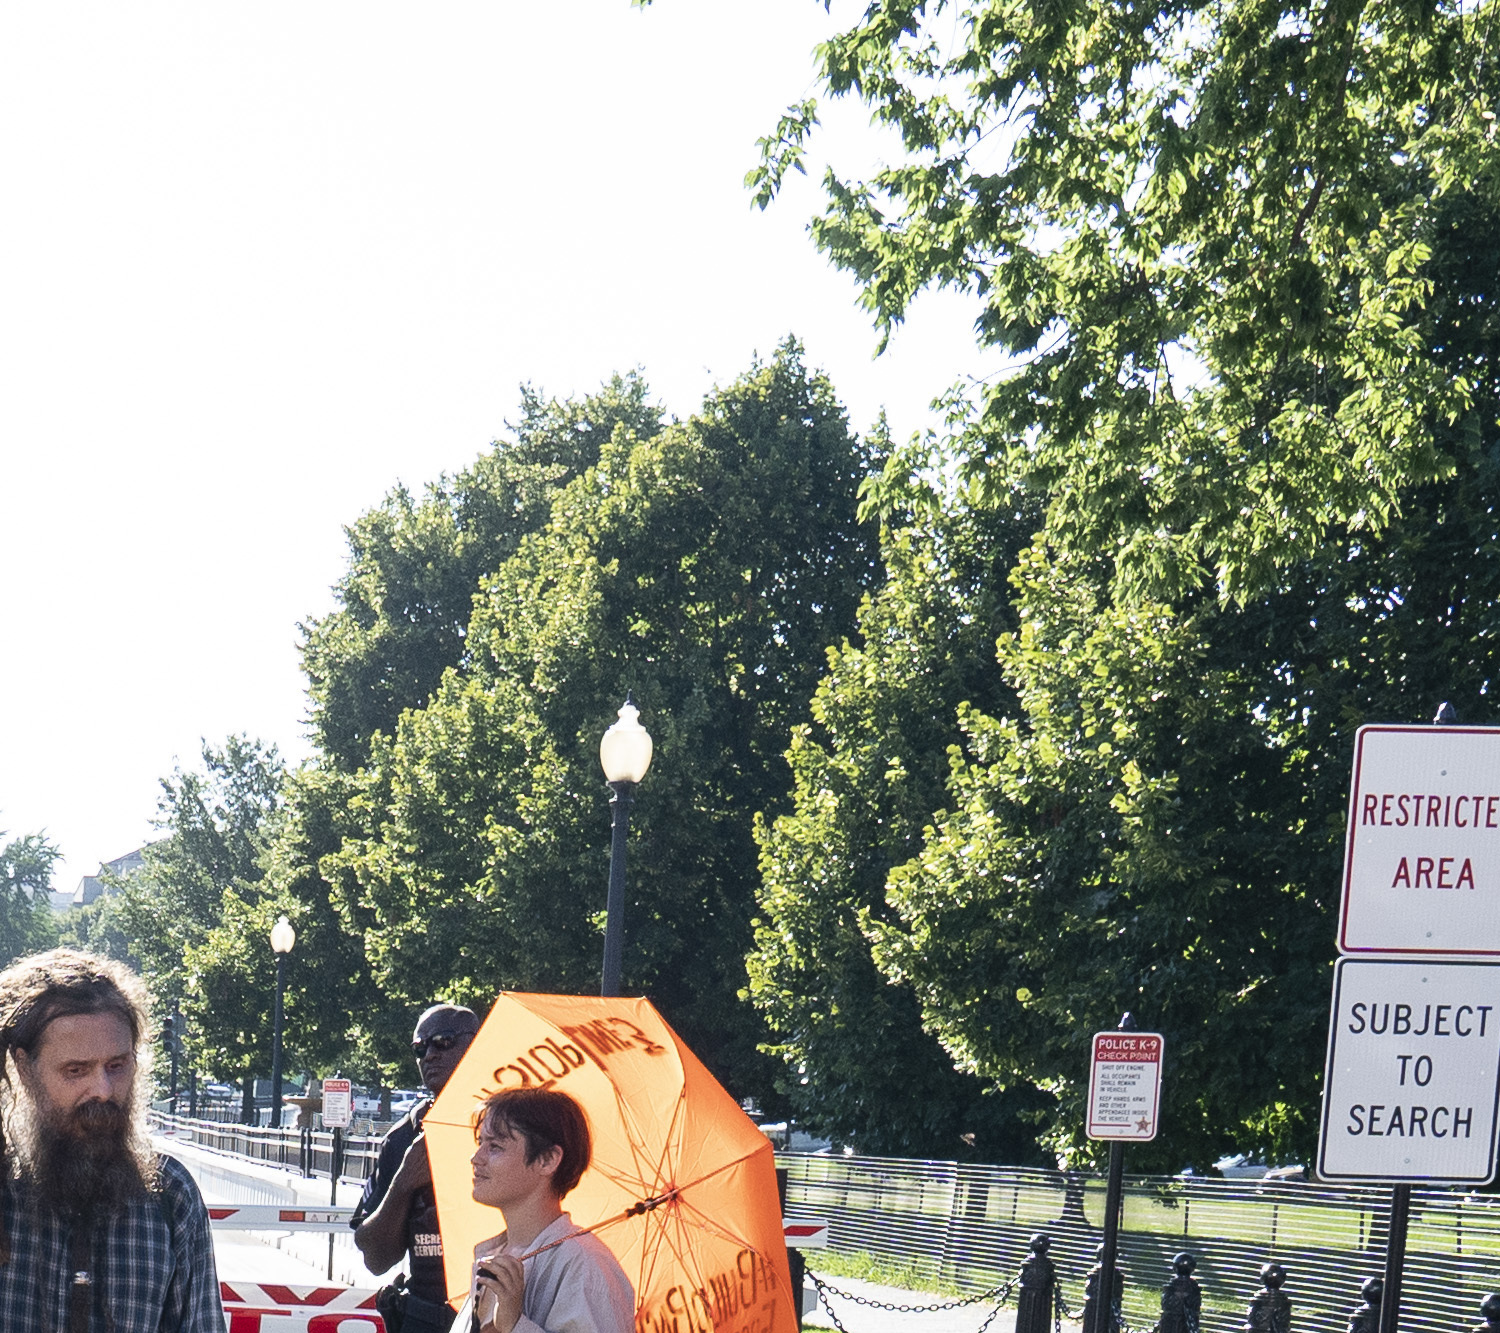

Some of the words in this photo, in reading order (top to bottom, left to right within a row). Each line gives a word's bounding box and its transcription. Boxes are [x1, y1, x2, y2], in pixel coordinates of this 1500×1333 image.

[1392, 857, 1474, 890] AREA
[1349, 1002, 1493, 1037] SUBJECT
[1098, 1039, 1136, 1050] POLICE
[1140, 1040, 1157, 1050] K-9
[1097, 1052, 1128, 1060] CHECK
[1130, 1052, 1156, 1061] POINT
[1397, 1055, 1433, 1086] TO
[1347, 1105, 1472, 1138] SEARCH
[415, 1234, 441, 1244] SECRE
[414, 1245, 443, 1256] SERVIC
